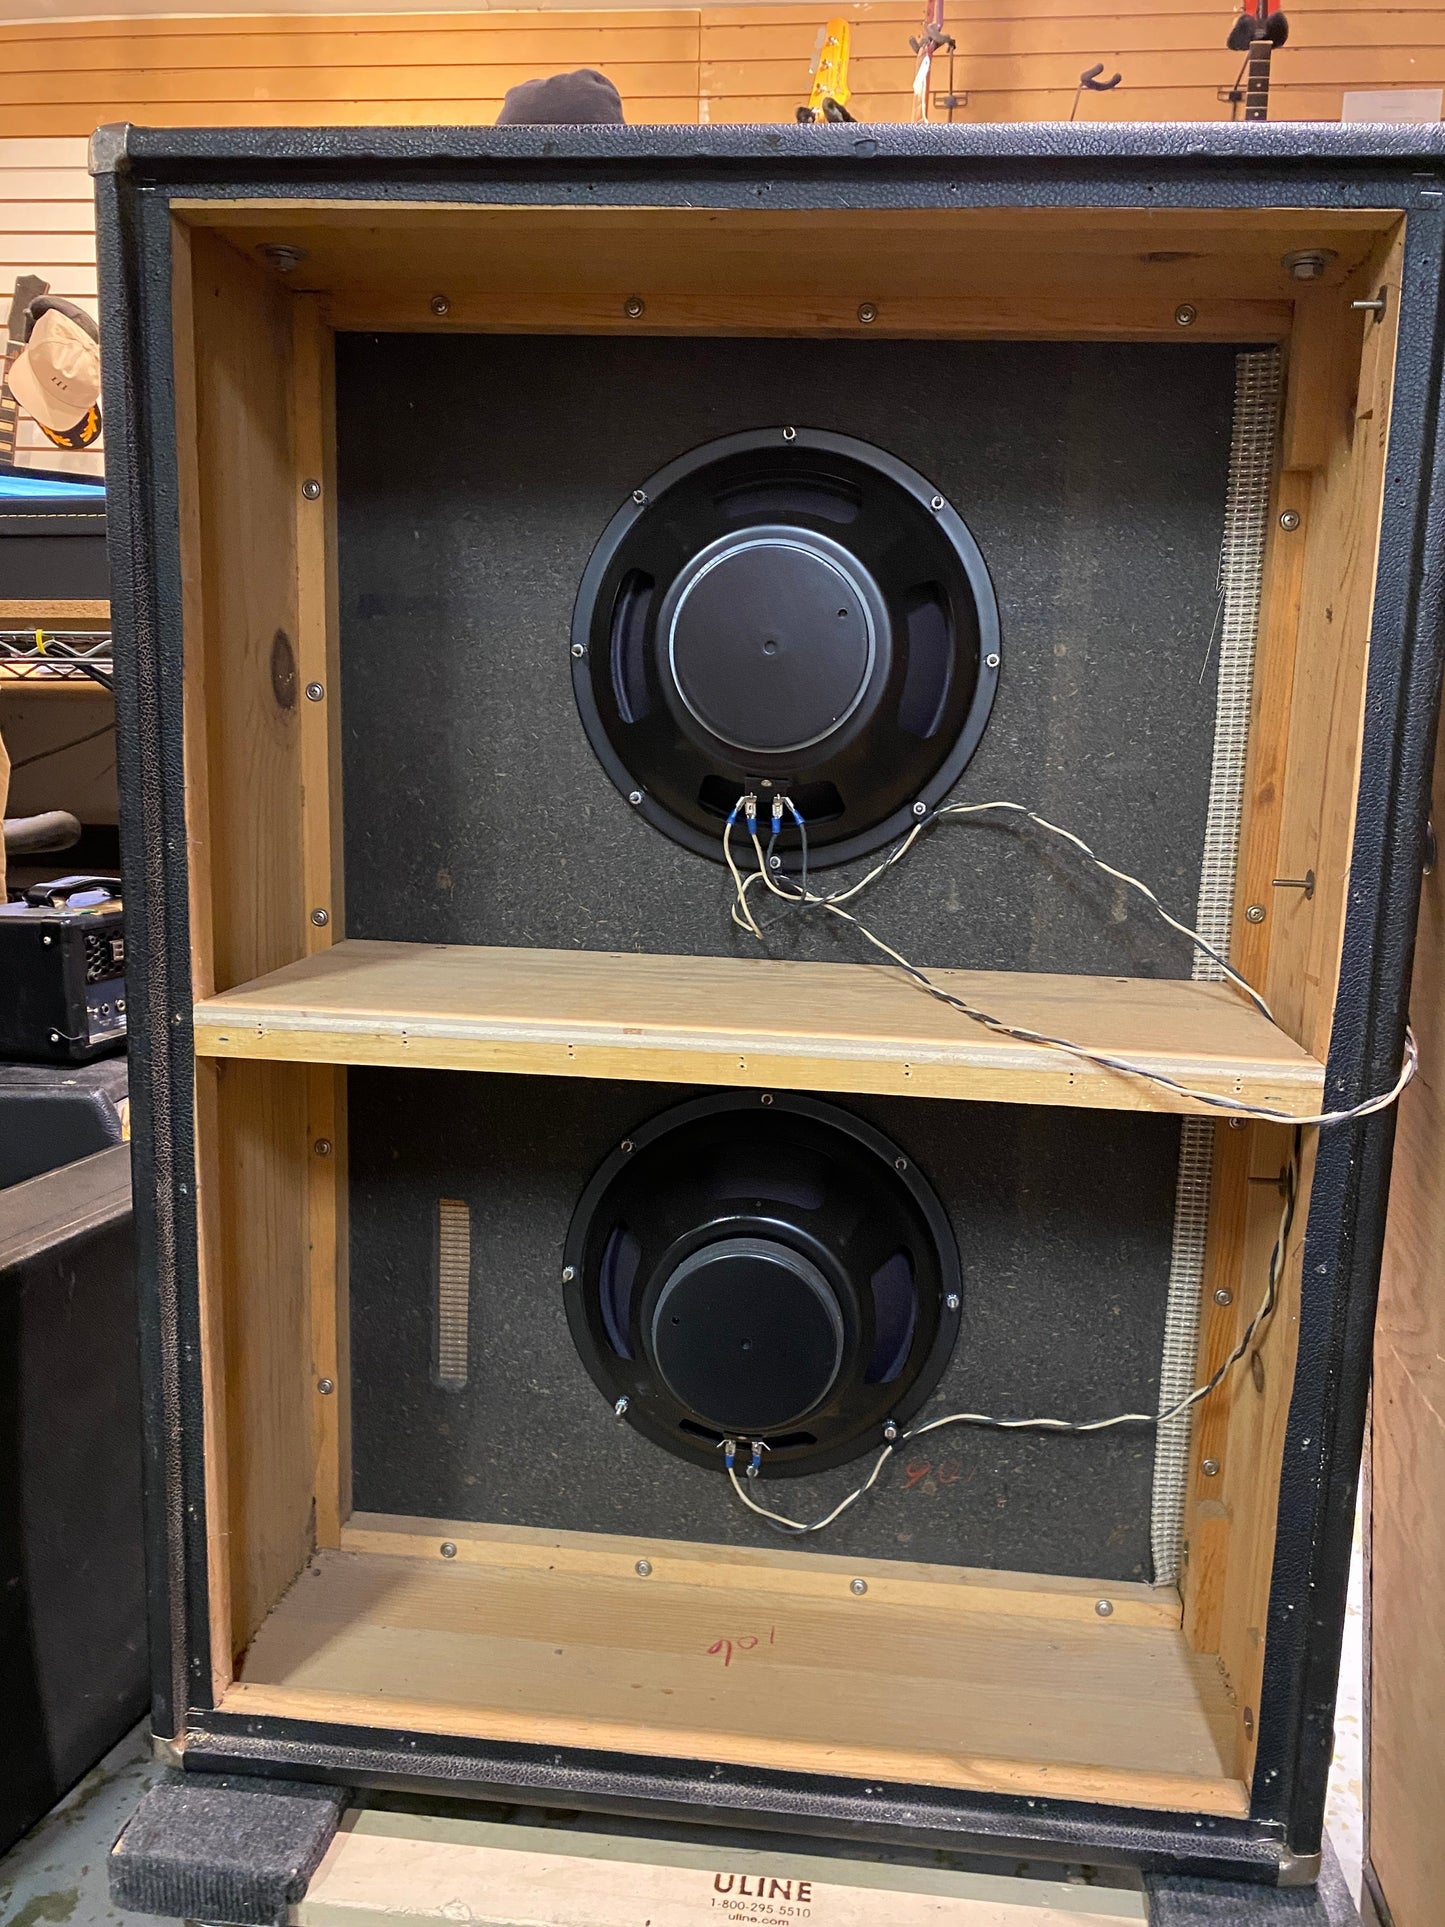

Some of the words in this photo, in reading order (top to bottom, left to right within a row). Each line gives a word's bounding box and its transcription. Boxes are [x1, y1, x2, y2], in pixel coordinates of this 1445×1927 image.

[713, 1873, 812, 1902] ULINE
[779, 1905, 811, 1919] 5510
[728, 1913, 789, 1926] uline.com
